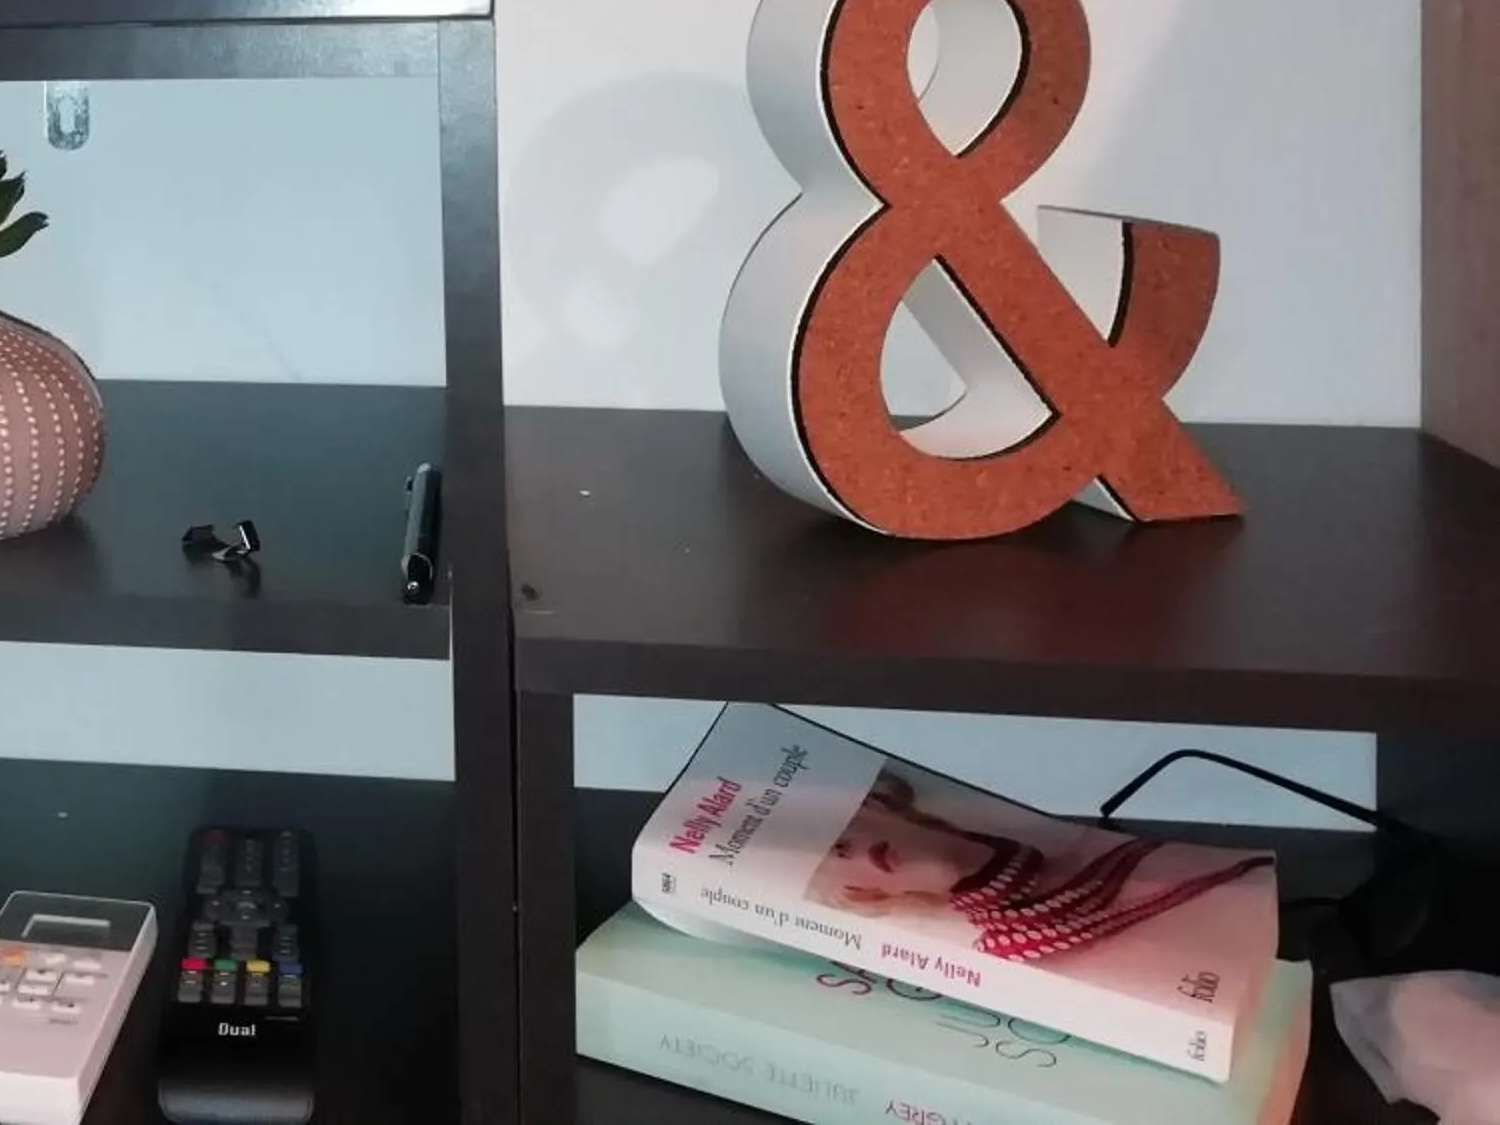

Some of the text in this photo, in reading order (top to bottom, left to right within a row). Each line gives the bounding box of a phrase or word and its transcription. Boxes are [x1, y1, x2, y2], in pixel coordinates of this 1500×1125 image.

[669, 776, 742, 855] Nelly Alard
[708, 813, 764, 867] Moment
[772, 743, 812, 789] couple
[700, 886, 981, 987] Nelly Alard Moment d'un couple
[1176, 970, 1220, 1004] folio
[218, 1021, 256, 1036] Dual
